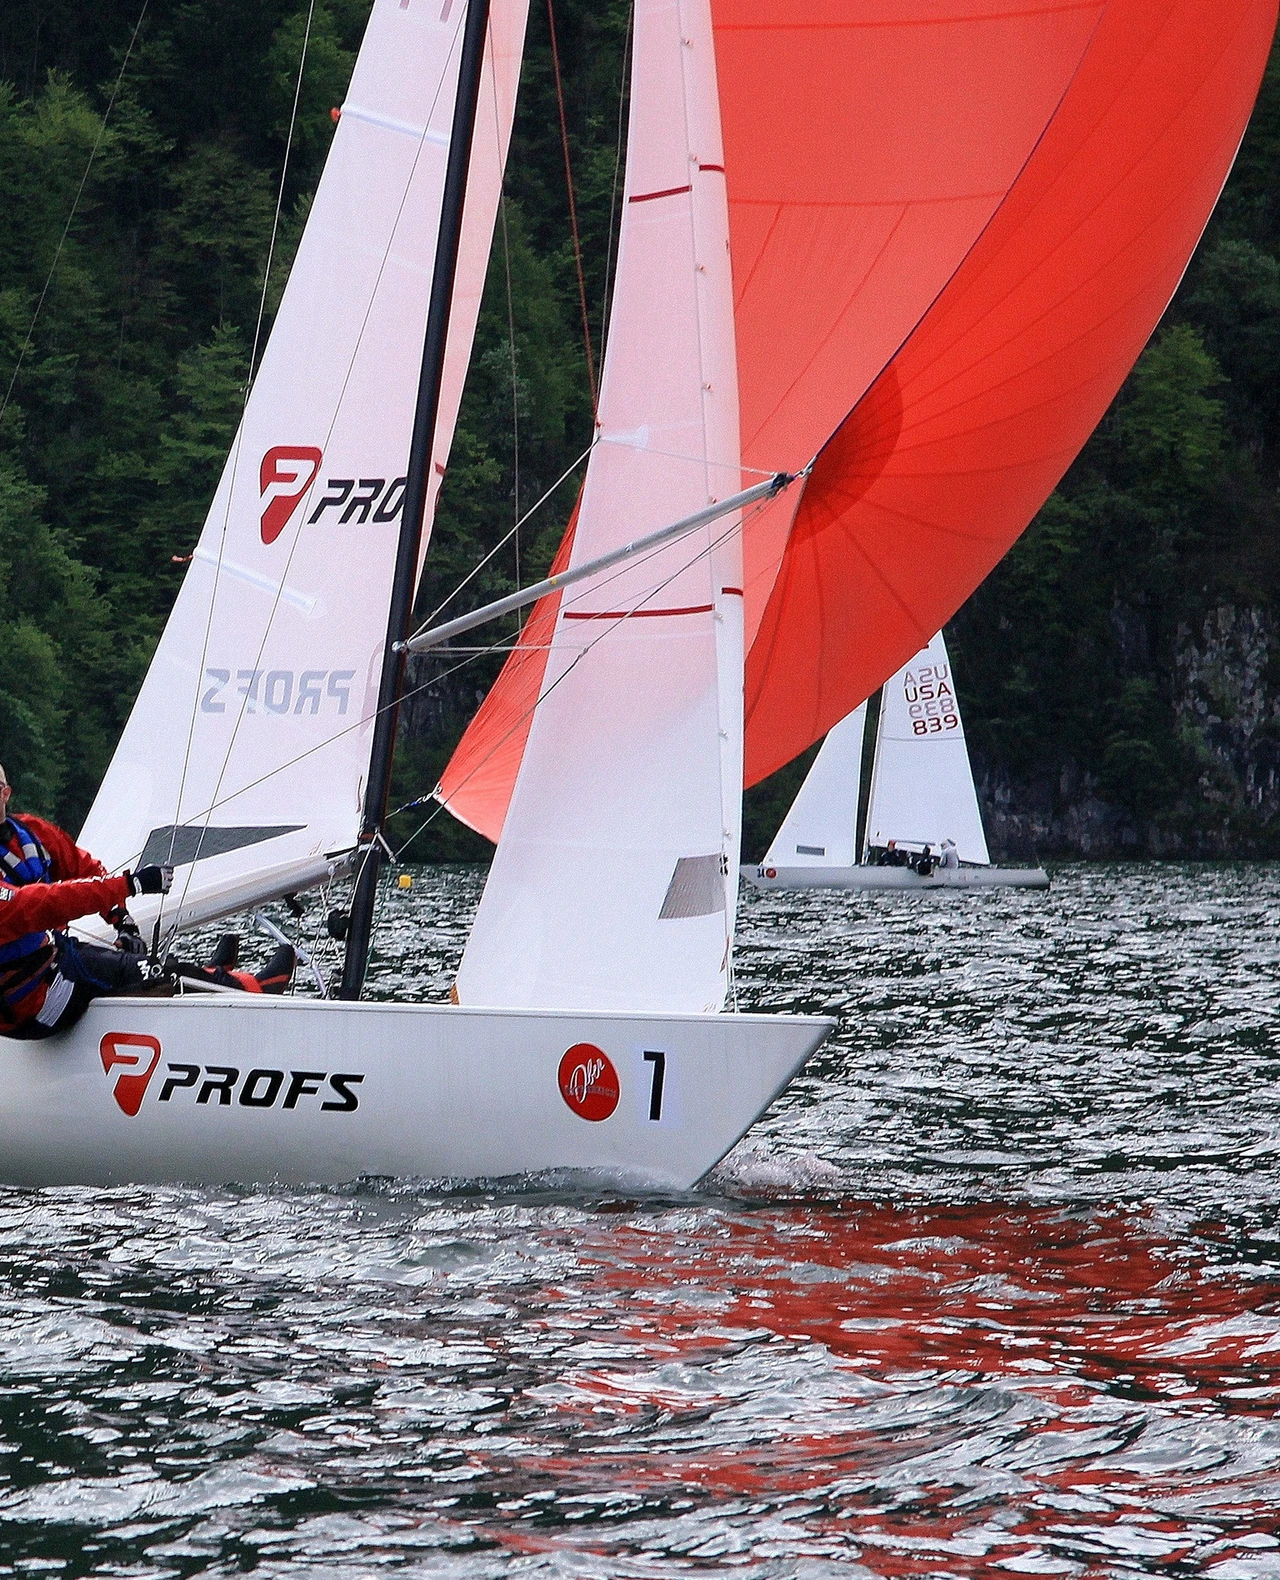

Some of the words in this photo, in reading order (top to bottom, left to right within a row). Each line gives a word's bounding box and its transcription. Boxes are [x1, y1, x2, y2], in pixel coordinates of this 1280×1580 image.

[307, 476, 409, 525] PRO
[905, 681, 952, 702] USA
[912, 714, 959, 735] 839
[158, 1062, 366, 1113] PROFS
